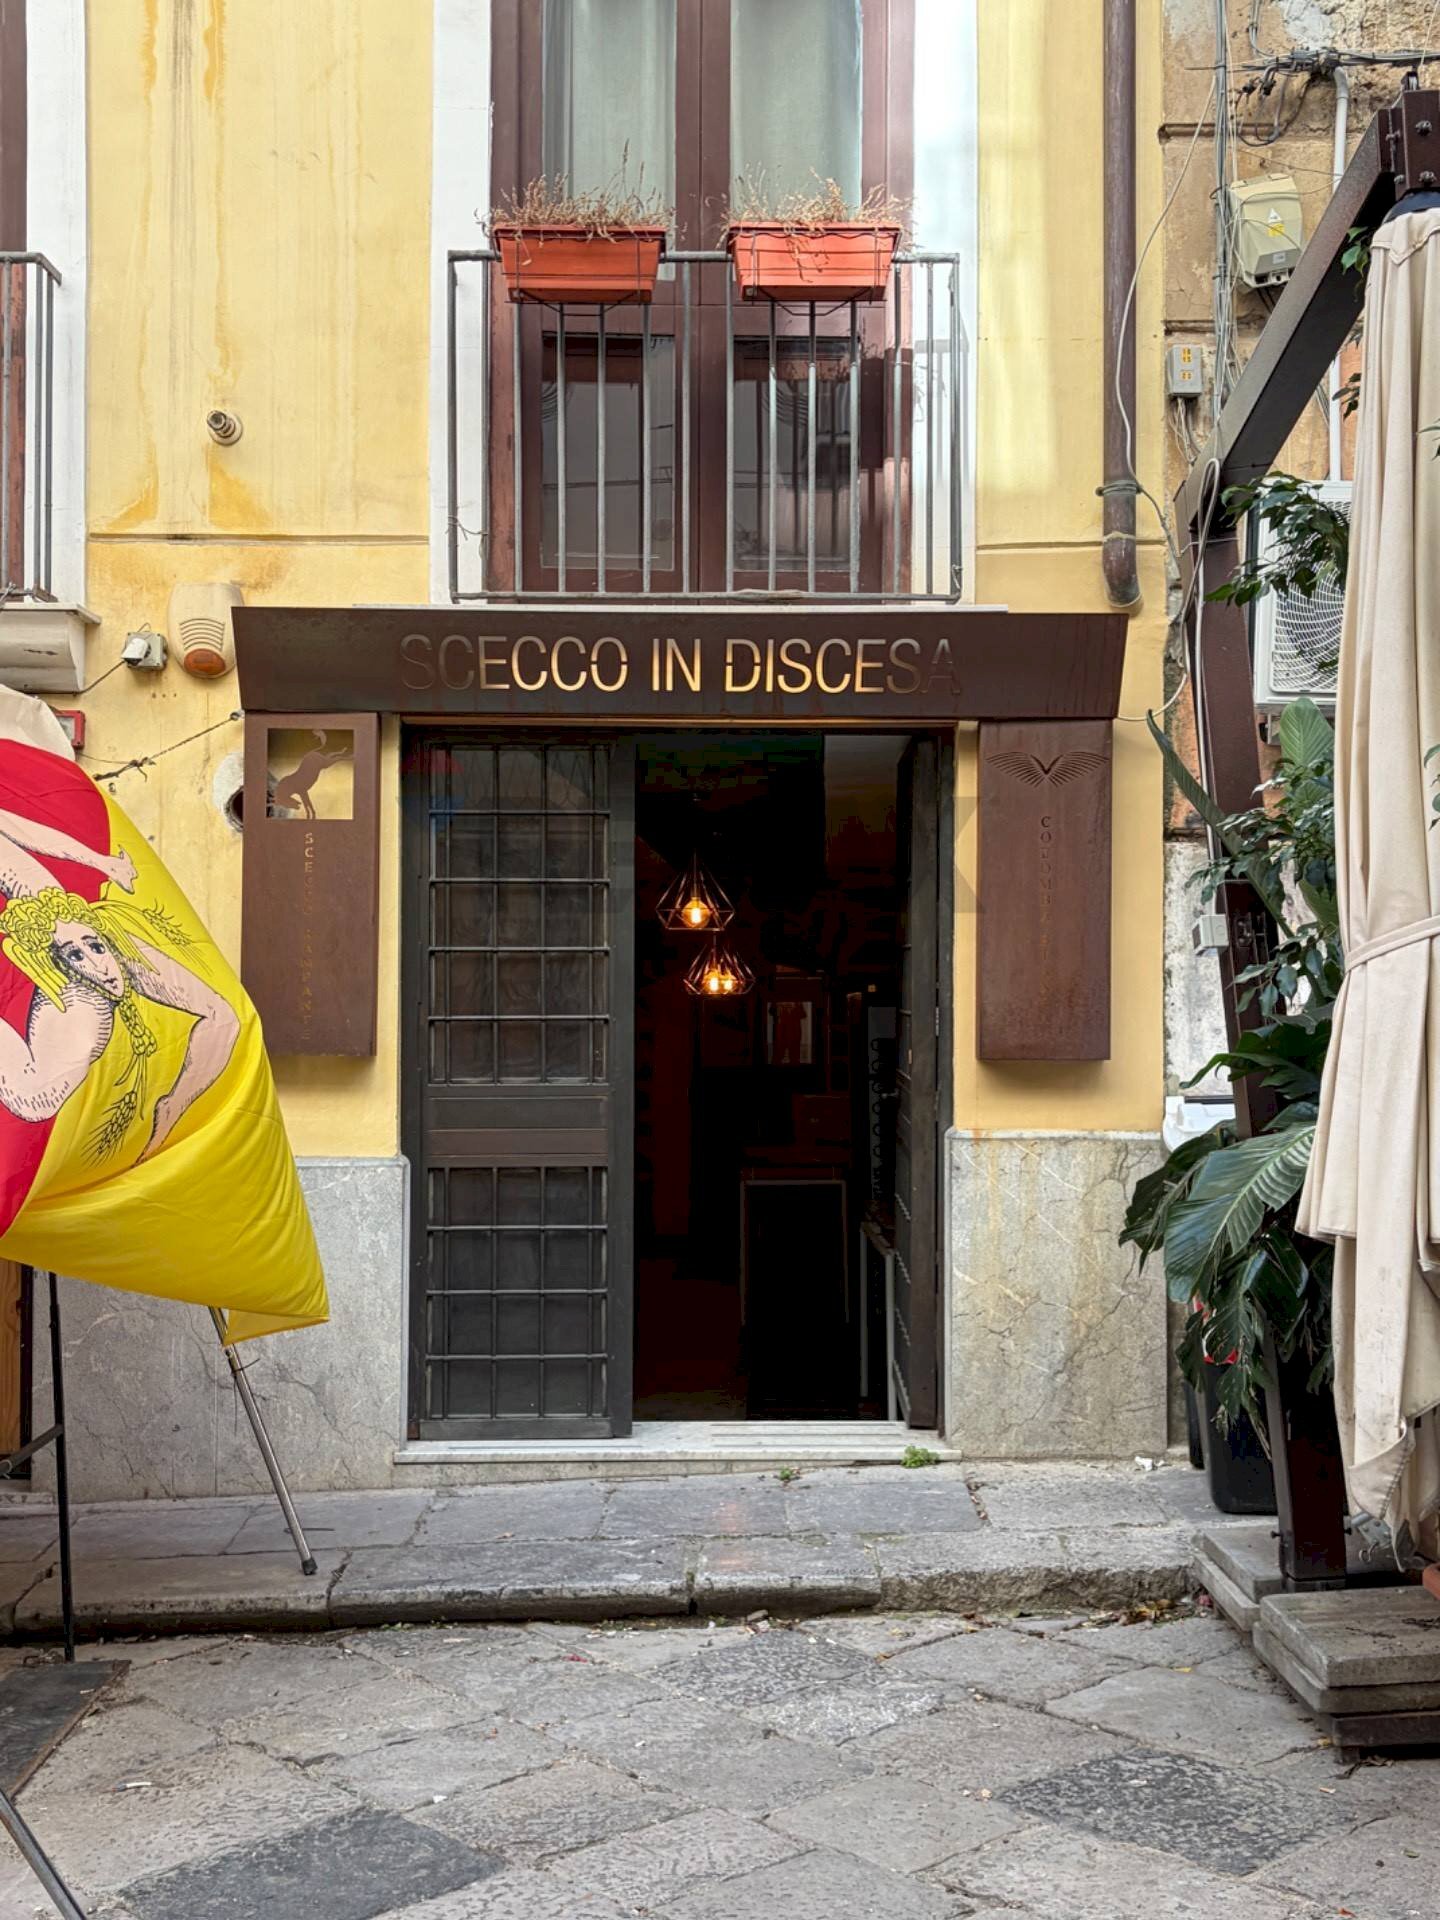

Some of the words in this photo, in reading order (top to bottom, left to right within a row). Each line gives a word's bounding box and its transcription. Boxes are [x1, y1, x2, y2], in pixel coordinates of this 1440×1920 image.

[401, 634, 628, 692] SCECCO
[652, 638, 701, 692] IN
[725, 638, 960, 693] DISCESA
